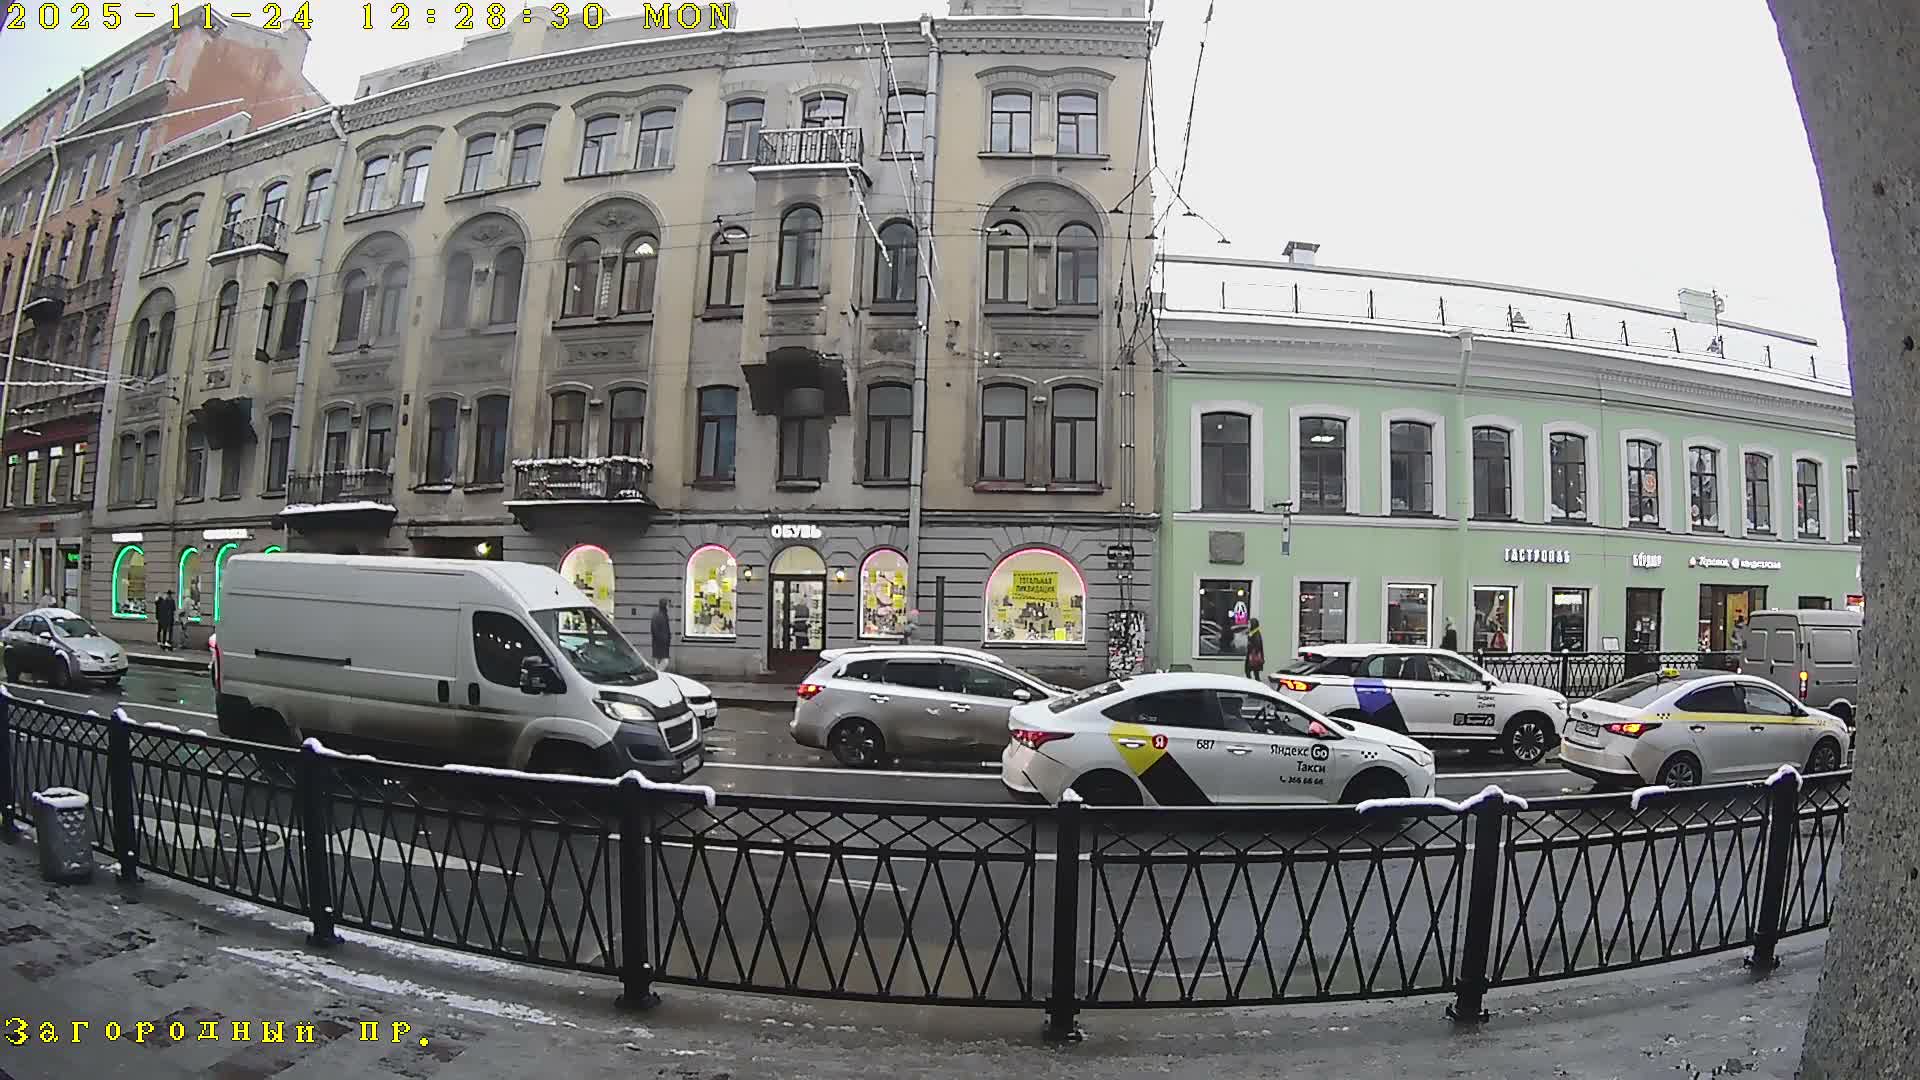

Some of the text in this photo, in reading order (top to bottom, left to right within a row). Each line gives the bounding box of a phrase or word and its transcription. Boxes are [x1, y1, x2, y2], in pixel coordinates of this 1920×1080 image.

[771, 524, 822, 539] ОБУВЬ
[1196, 739, 1215, 750] 687
[1270, 744, 1329, 760] Яндекс Go
[1297, 760, 1326, 773] Такси
